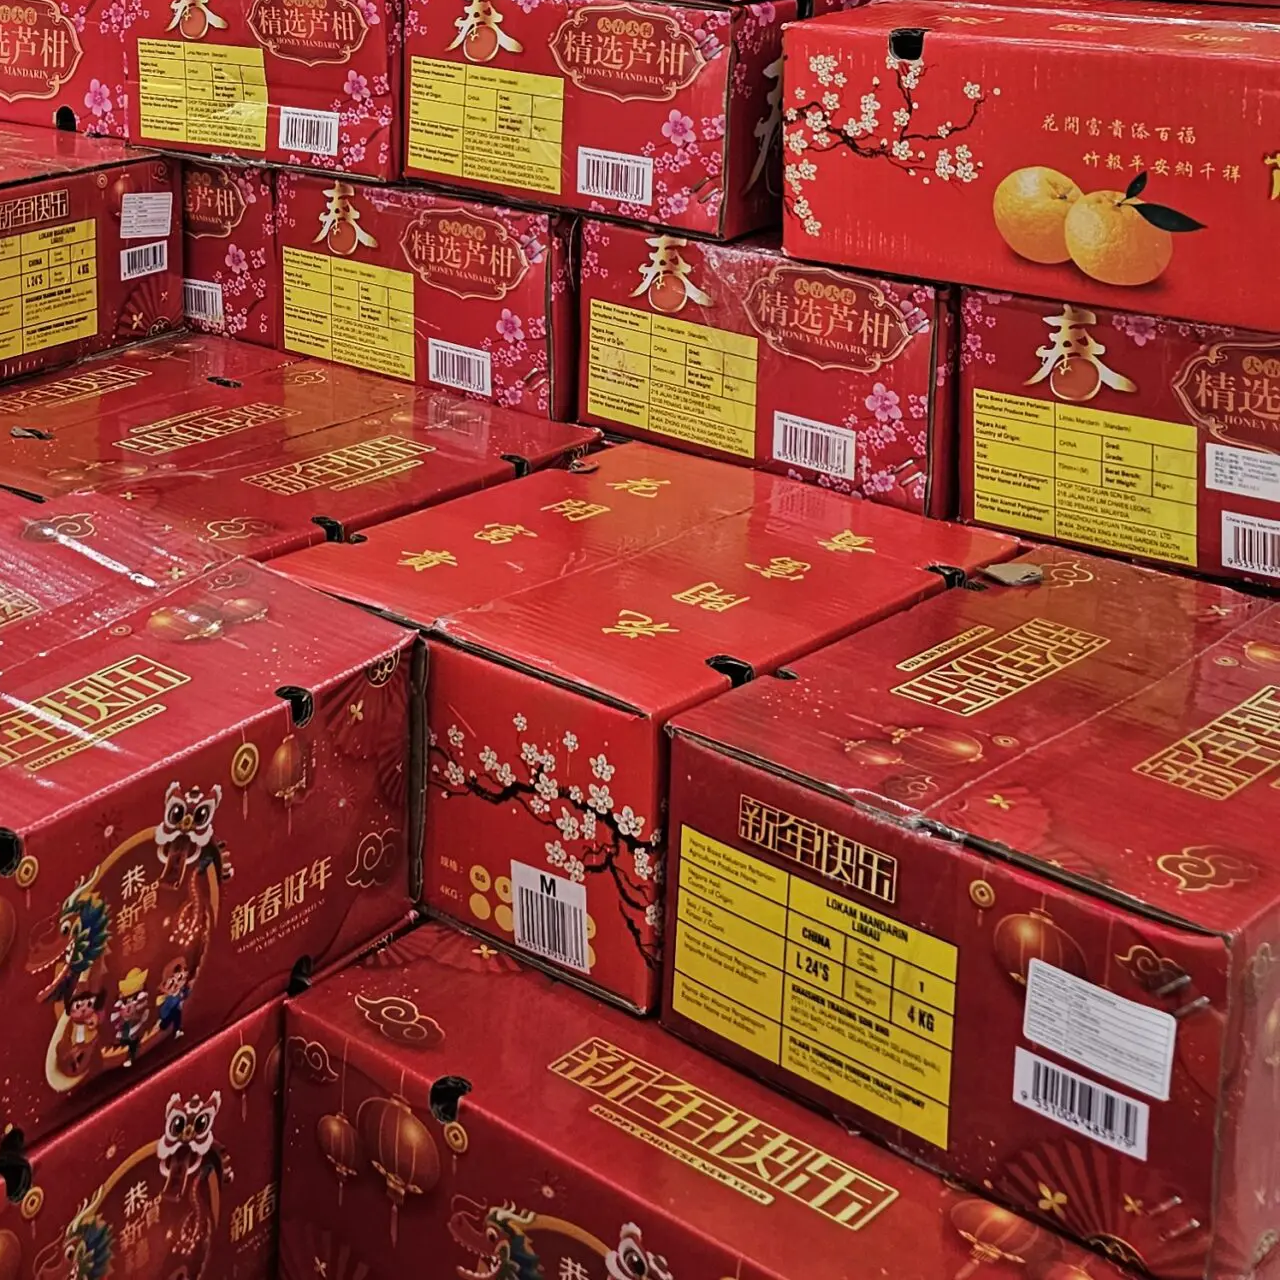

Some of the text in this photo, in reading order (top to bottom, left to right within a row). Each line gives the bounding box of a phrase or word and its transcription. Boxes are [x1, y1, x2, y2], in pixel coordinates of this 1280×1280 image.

[258, 6, 356, 41] 精选芦柑
[277, 36, 341, 50] HONEY MANDARIN
[563, 31, 690, 77] 精选芦柑
[4, 65, 49, 80] MANDARIN
[582, 65, 665, 86] HONEY MANDARIN
[1042, 114, 1198, 145] 花開富貴添百福
[1083, 151, 1242, 183] 竹報平安納千祥
[411, 230, 517, 279] 精选芦柑
[428, 263, 497, 286] HONEY MANDARIN
[757, 289, 895, 349] 精选芦柑
[778, 328, 869, 357] HONEY MANDARIN
[29, 749, 65, 770] HAPPY
[112, 716, 135, 731] NEW
[137, 705, 161, 719] YEAR
[738, 793, 898, 904] 新年快乐
[230, 855, 333, 942] 新春好年
[540, 874, 556, 897] M
[826, 896, 908, 943] LOKAM MANDARIN
[852, 921, 881, 942] LIMAU
[802, 927, 831, 950] CHINA
[796, 951, 830, 982] L 24'S
[907, 1005, 935, 1033] 4 KG
[547, 1037, 900, 1232] 新年快乐
[593, 1106, 767, 1201] HAPPY CHINESE NEW YEAR
